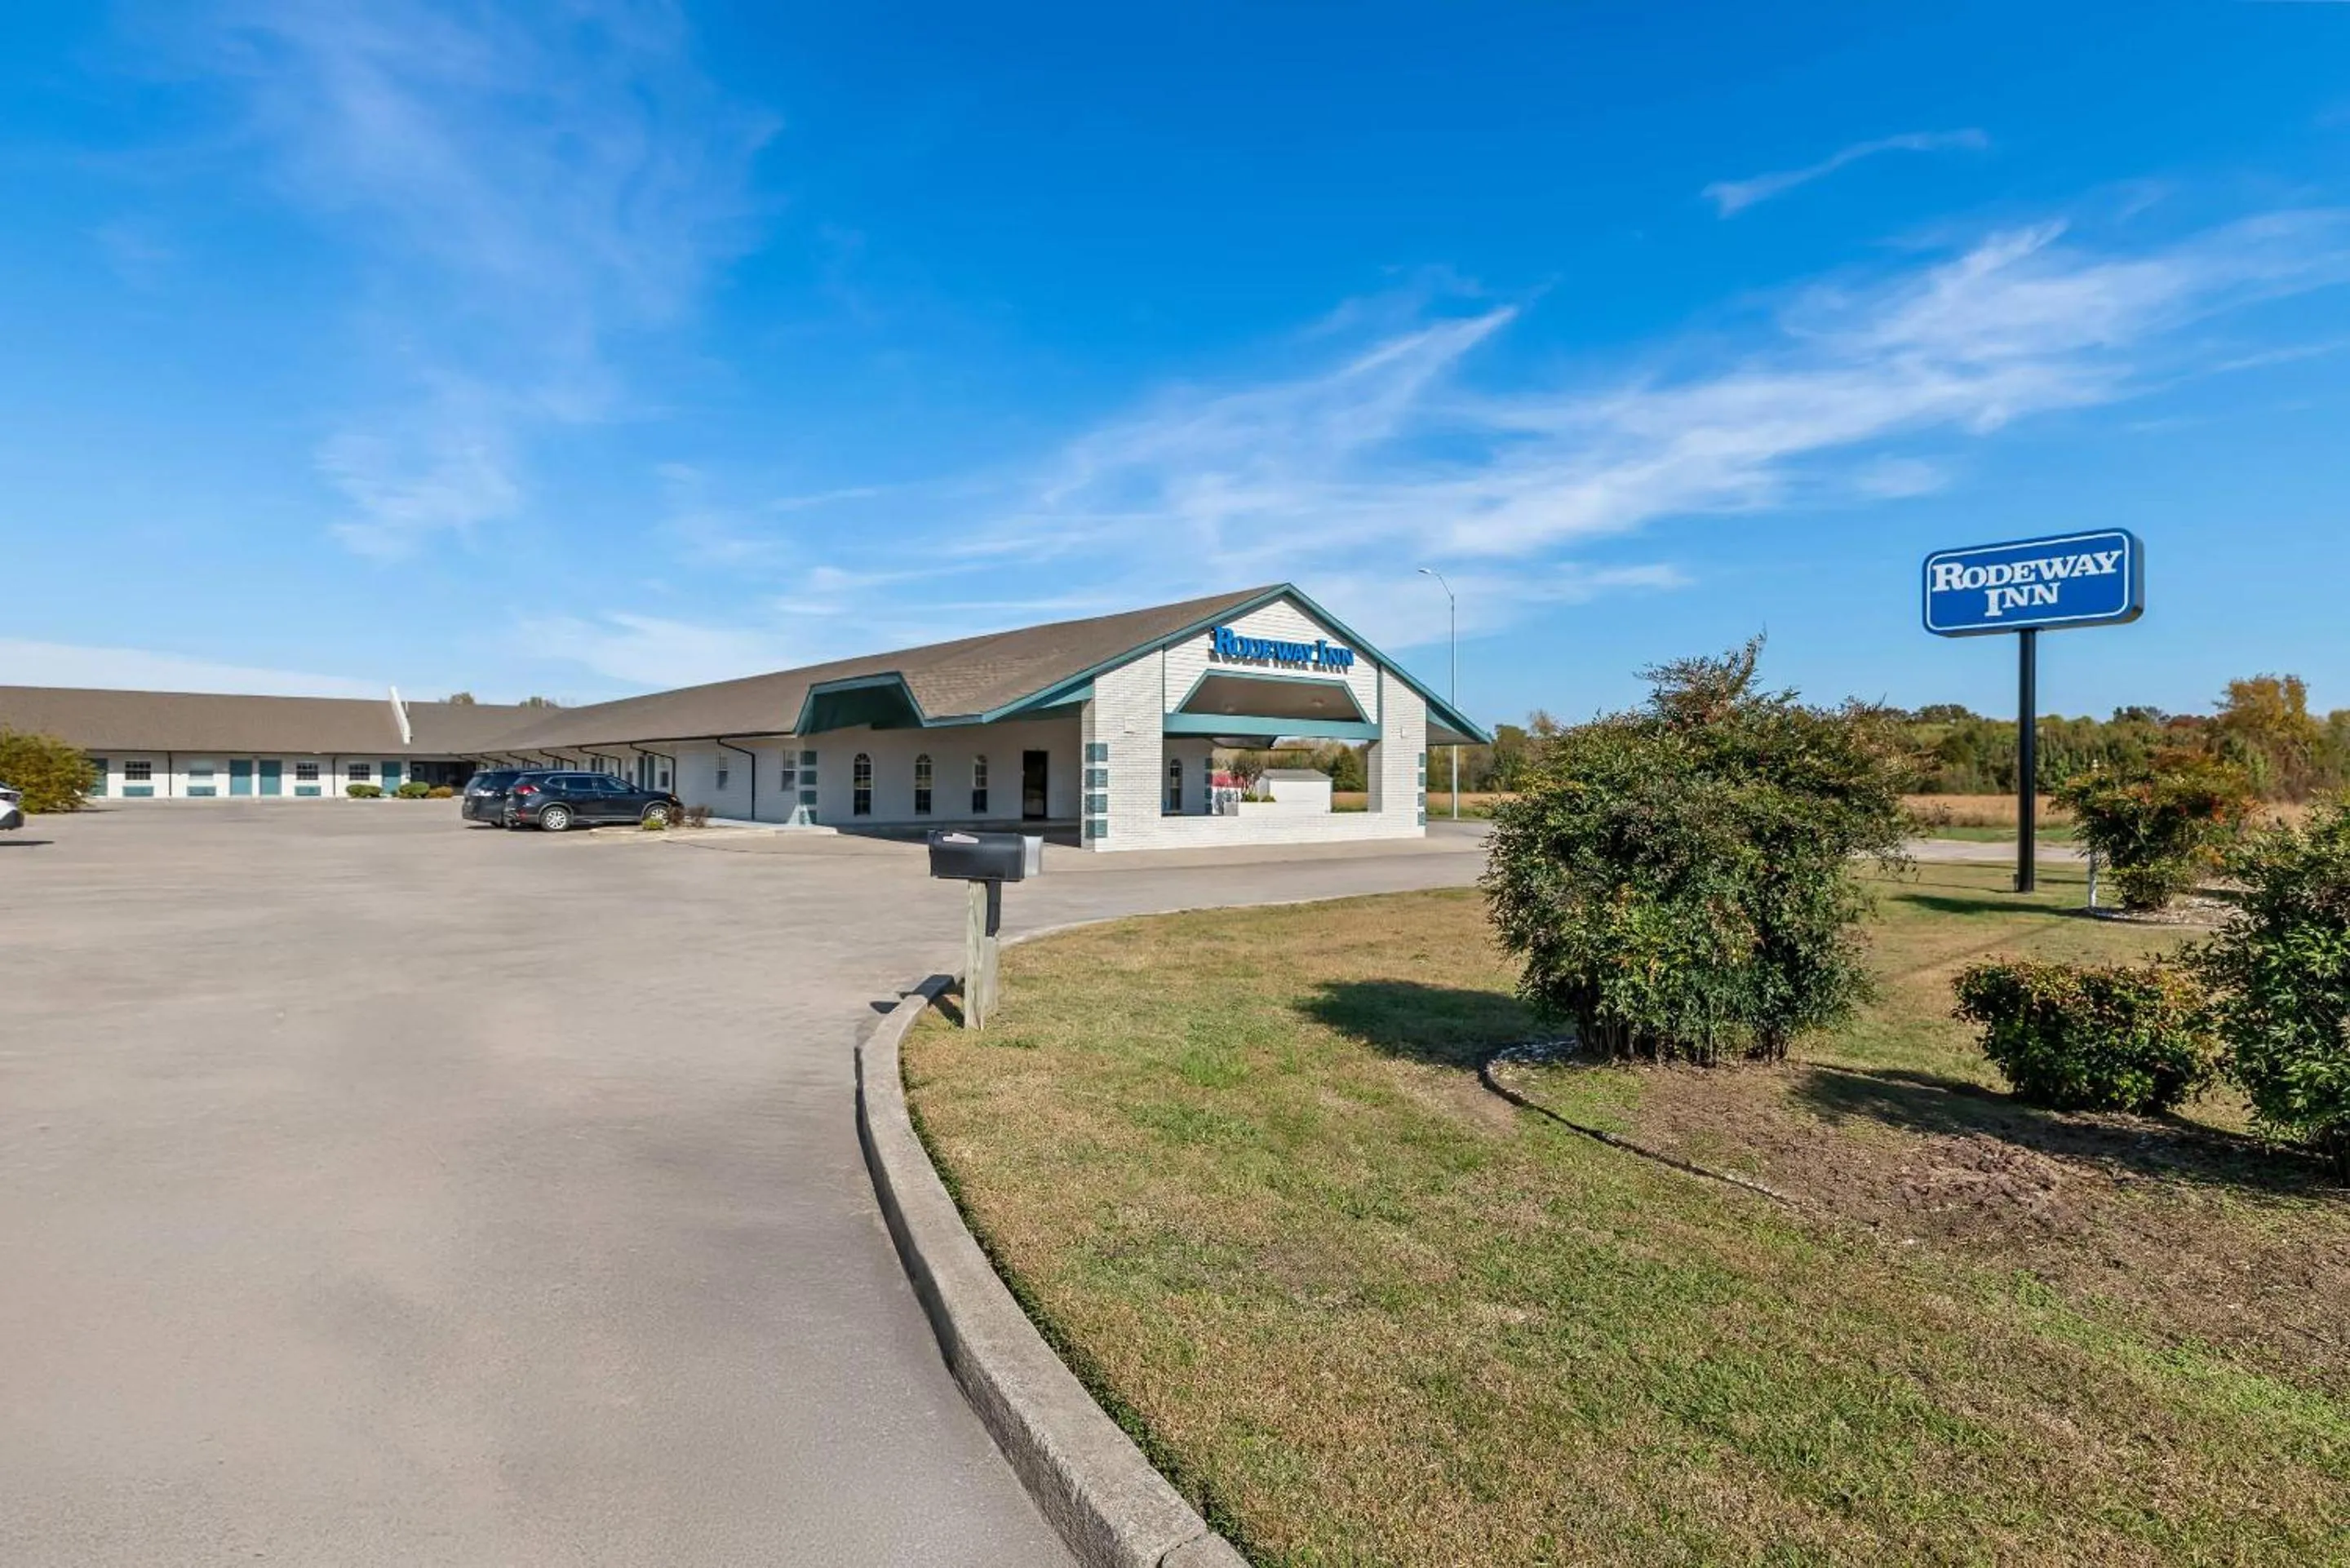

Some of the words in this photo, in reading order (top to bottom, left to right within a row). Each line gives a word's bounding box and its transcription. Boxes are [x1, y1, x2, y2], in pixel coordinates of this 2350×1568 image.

[1931, 550, 2123, 592] RODEWAY
[1984, 582, 2060, 616] INN
[1214, 626, 1314, 662] RODEWAY
[1315, 640, 1355, 666] INN
